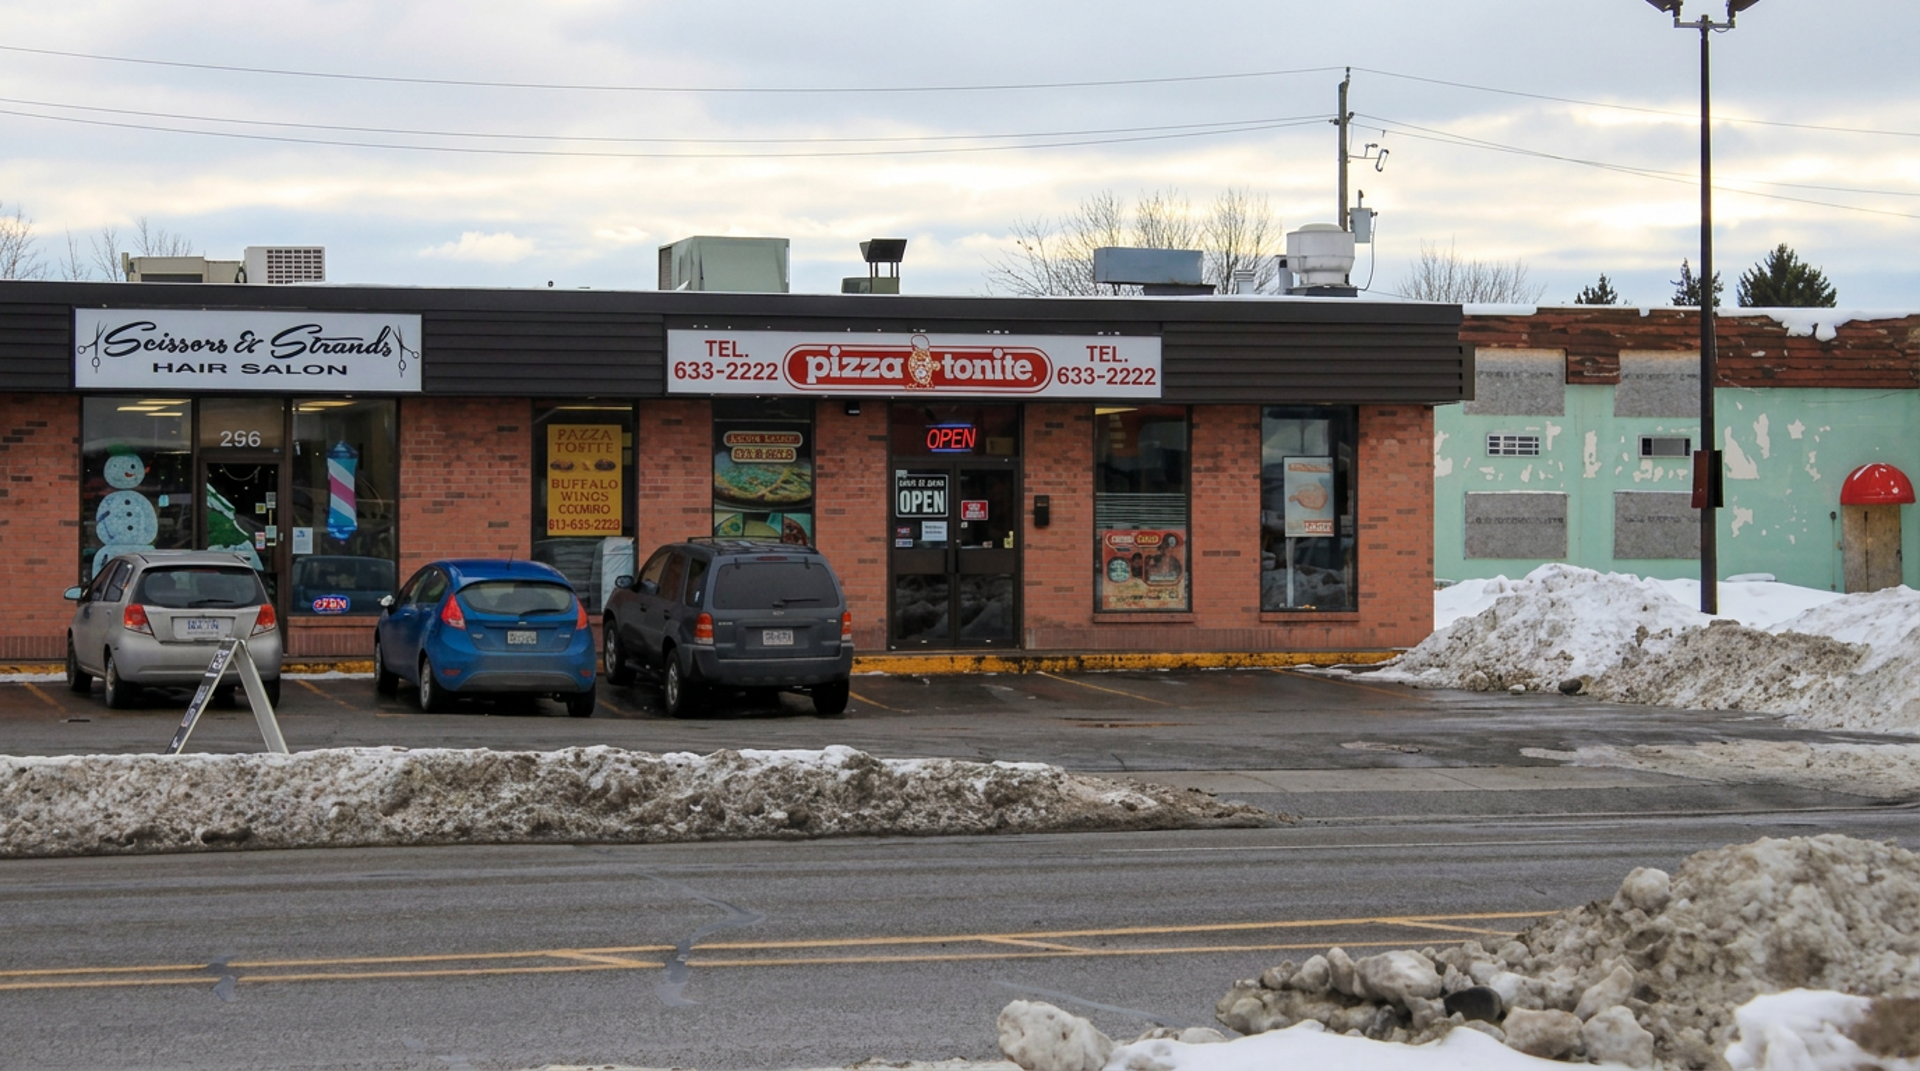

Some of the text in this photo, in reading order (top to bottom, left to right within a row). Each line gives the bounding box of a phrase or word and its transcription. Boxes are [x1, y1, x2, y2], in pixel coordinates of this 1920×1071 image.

[104, 321, 392, 359] Scissors & Strands
[705, 340, 750, 358] TEL.
[1086, 345, 1128, 363] TEL.
[153, 363, 348, 376] HAIR SALON
[673, 361, 778, 381] 633-2222
[806, 345, 1033, 384] pizza tonite
[1057, 367, 1157, 386] 633-2222
[926, 428, 977, 449] OPEN
[551, 479, 619, 490] BUFFALO
[899, 490, 945, 513] OPEN
